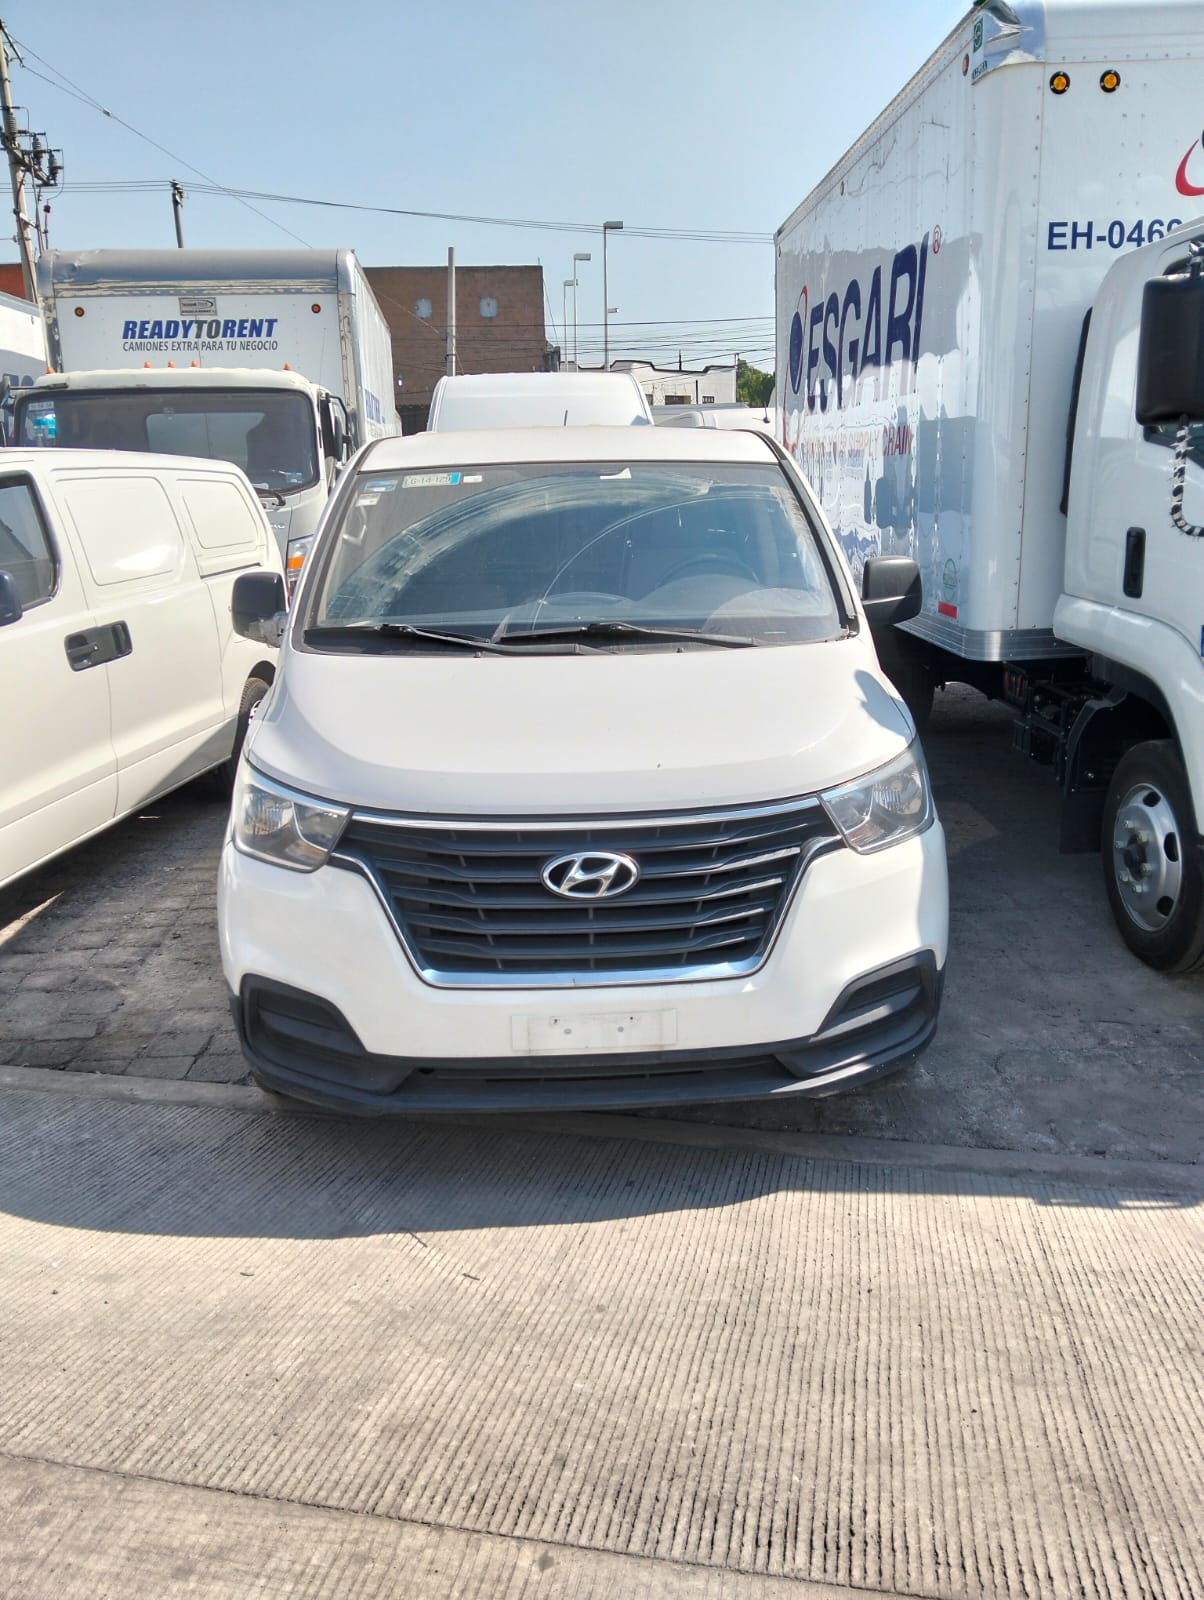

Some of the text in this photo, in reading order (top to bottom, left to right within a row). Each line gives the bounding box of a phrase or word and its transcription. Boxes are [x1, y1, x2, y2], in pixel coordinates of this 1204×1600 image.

[122, 319, 278, 340] READYTORENT
[805, 231, 930, 414] ESGARI
[122, 340, 278, 352] CAMIONES EXTRA PARA TU NEGOCIO
[882, 424, 914, 457] CHAIN
